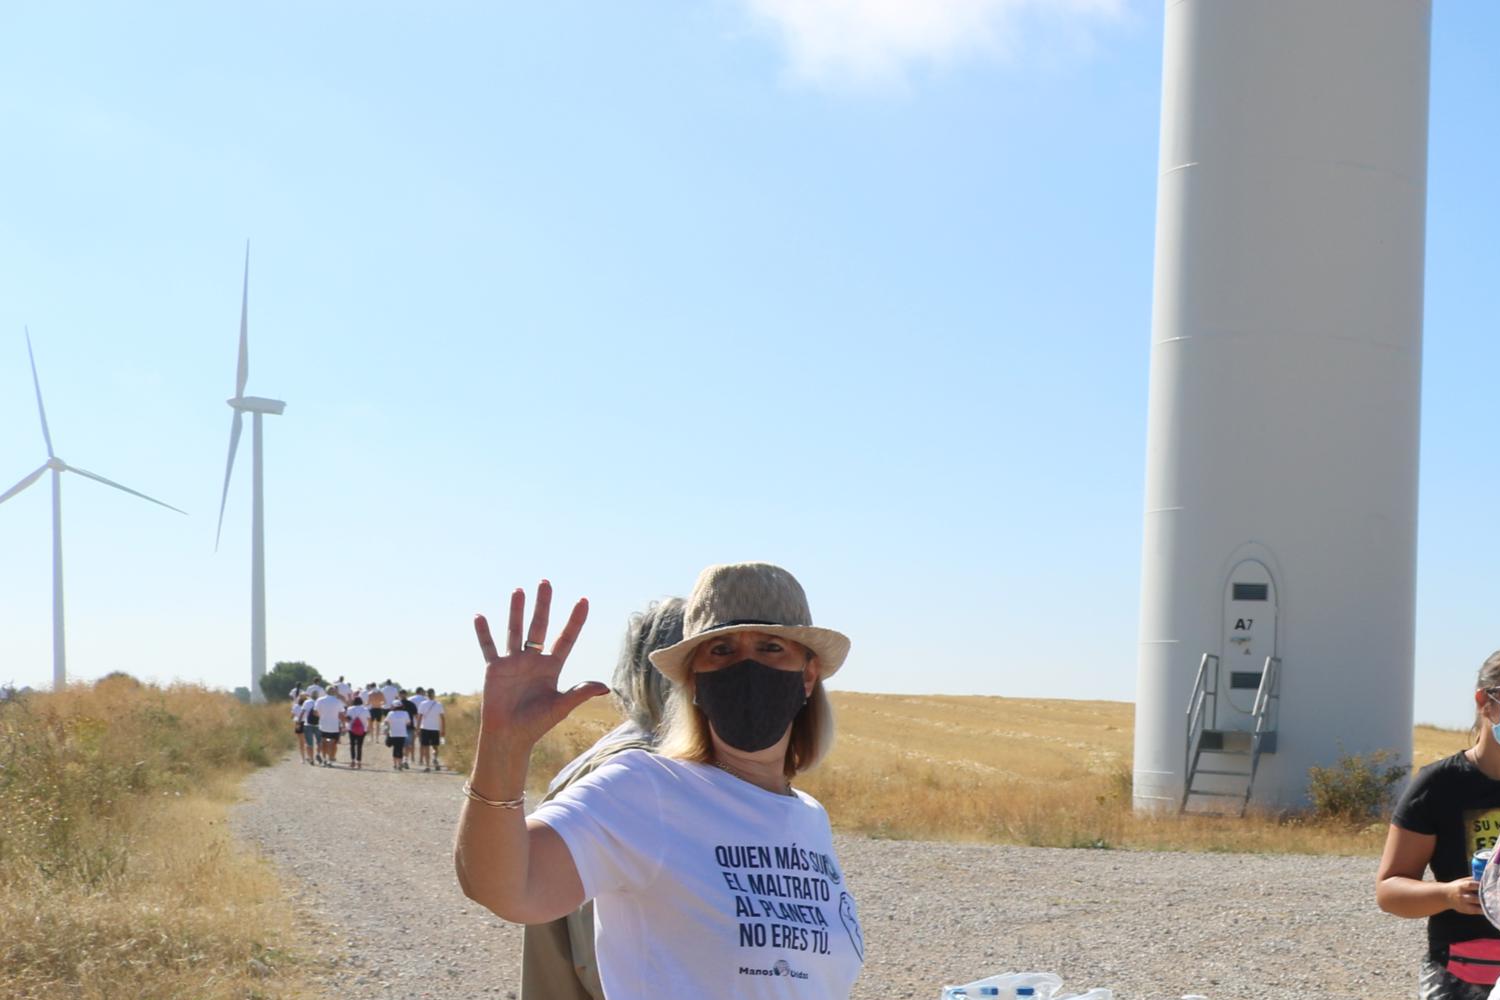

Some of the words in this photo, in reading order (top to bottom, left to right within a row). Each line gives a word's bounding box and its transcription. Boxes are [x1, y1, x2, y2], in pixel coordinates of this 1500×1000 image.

[1234, 618, 1253, 630] A7
[714, 845, 771, 868] QUIEN
[774, 843, 810, 871] MÁS
[722, 872, 748, 892] EL
[747, 874, 830, 902] MALTRATO
[736, 895, 761, 918] AL
[757, 899, 829, 928] PLANETA
[739, 923, 767, 948] NO
[771, 924, 809, 951] ERES
[739, 966, 774, 976] Manos
